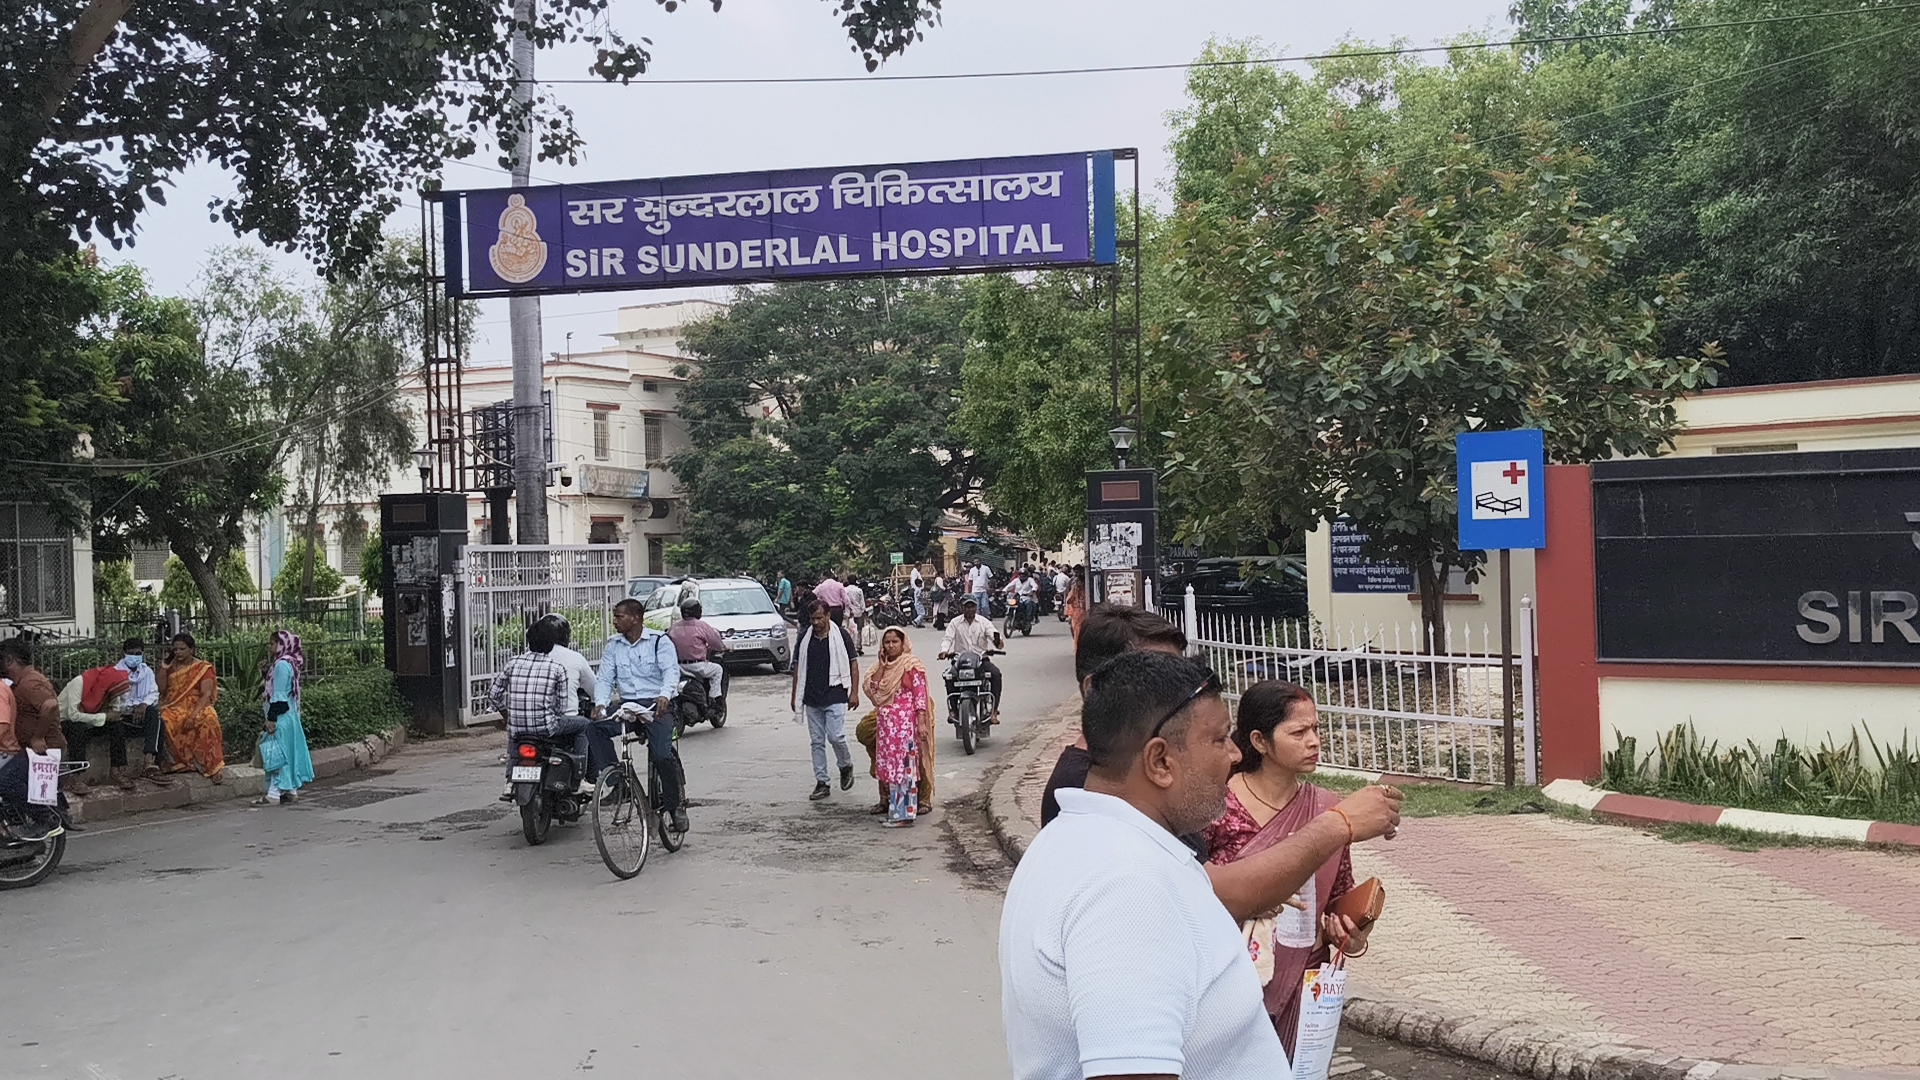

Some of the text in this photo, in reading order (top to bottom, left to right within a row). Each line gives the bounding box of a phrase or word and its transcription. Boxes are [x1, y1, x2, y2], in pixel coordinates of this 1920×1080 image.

[567, 169, 1064, 235] सर सुन्दरलाल चिकित्सालय
[637, 233, 860, 275] SUNDERLAL
[872, 223, 1064, 261] HOSPITAL
[1169, 546, 1198, 558] PARKING
[1796, 590, 1920, 645] SIR
